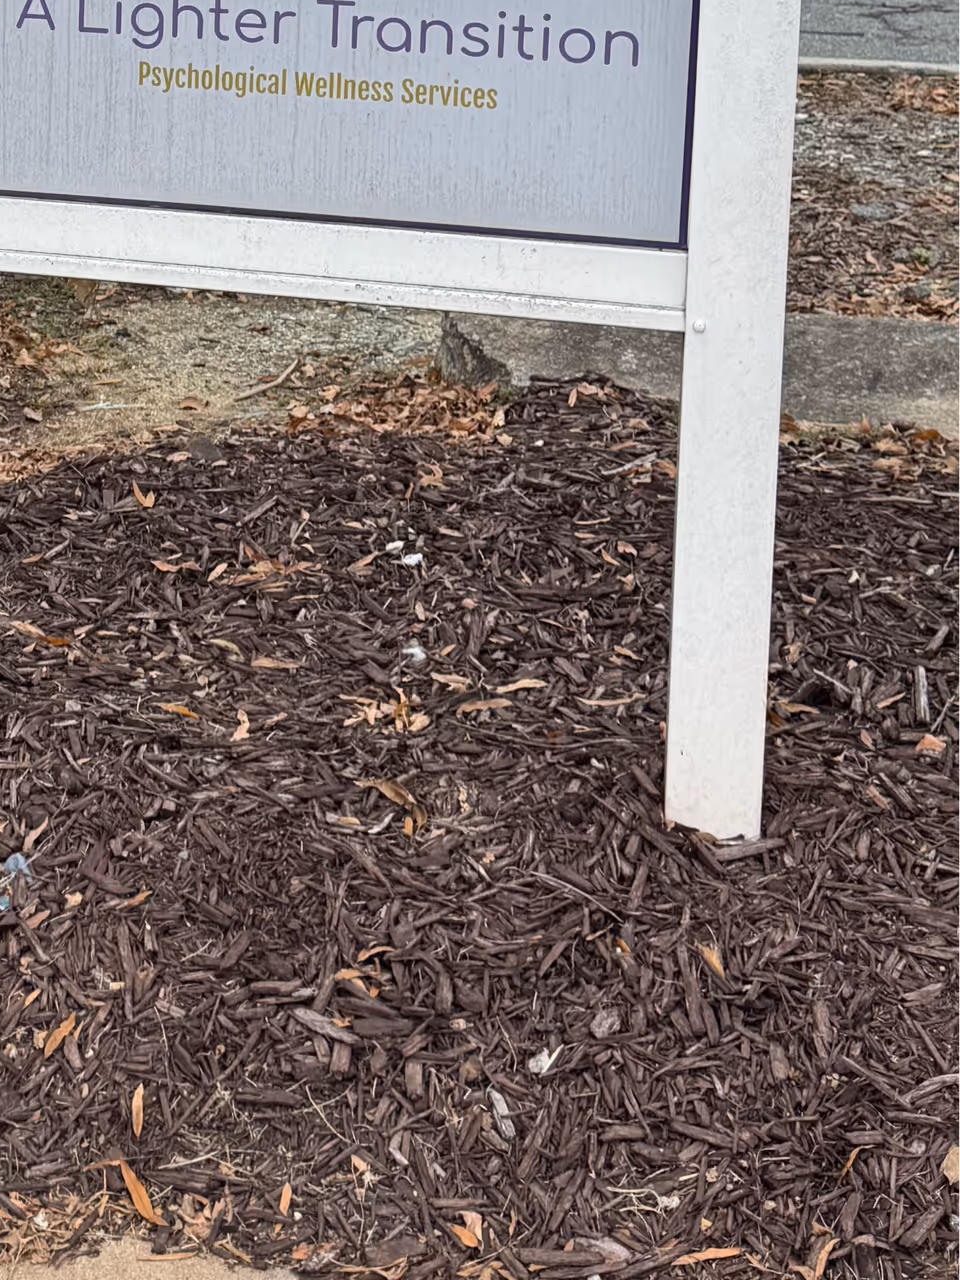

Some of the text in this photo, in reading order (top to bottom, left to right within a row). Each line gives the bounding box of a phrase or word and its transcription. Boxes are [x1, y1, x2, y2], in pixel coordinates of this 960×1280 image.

[137, 61, 498, 109] Psychological Wellness Services
